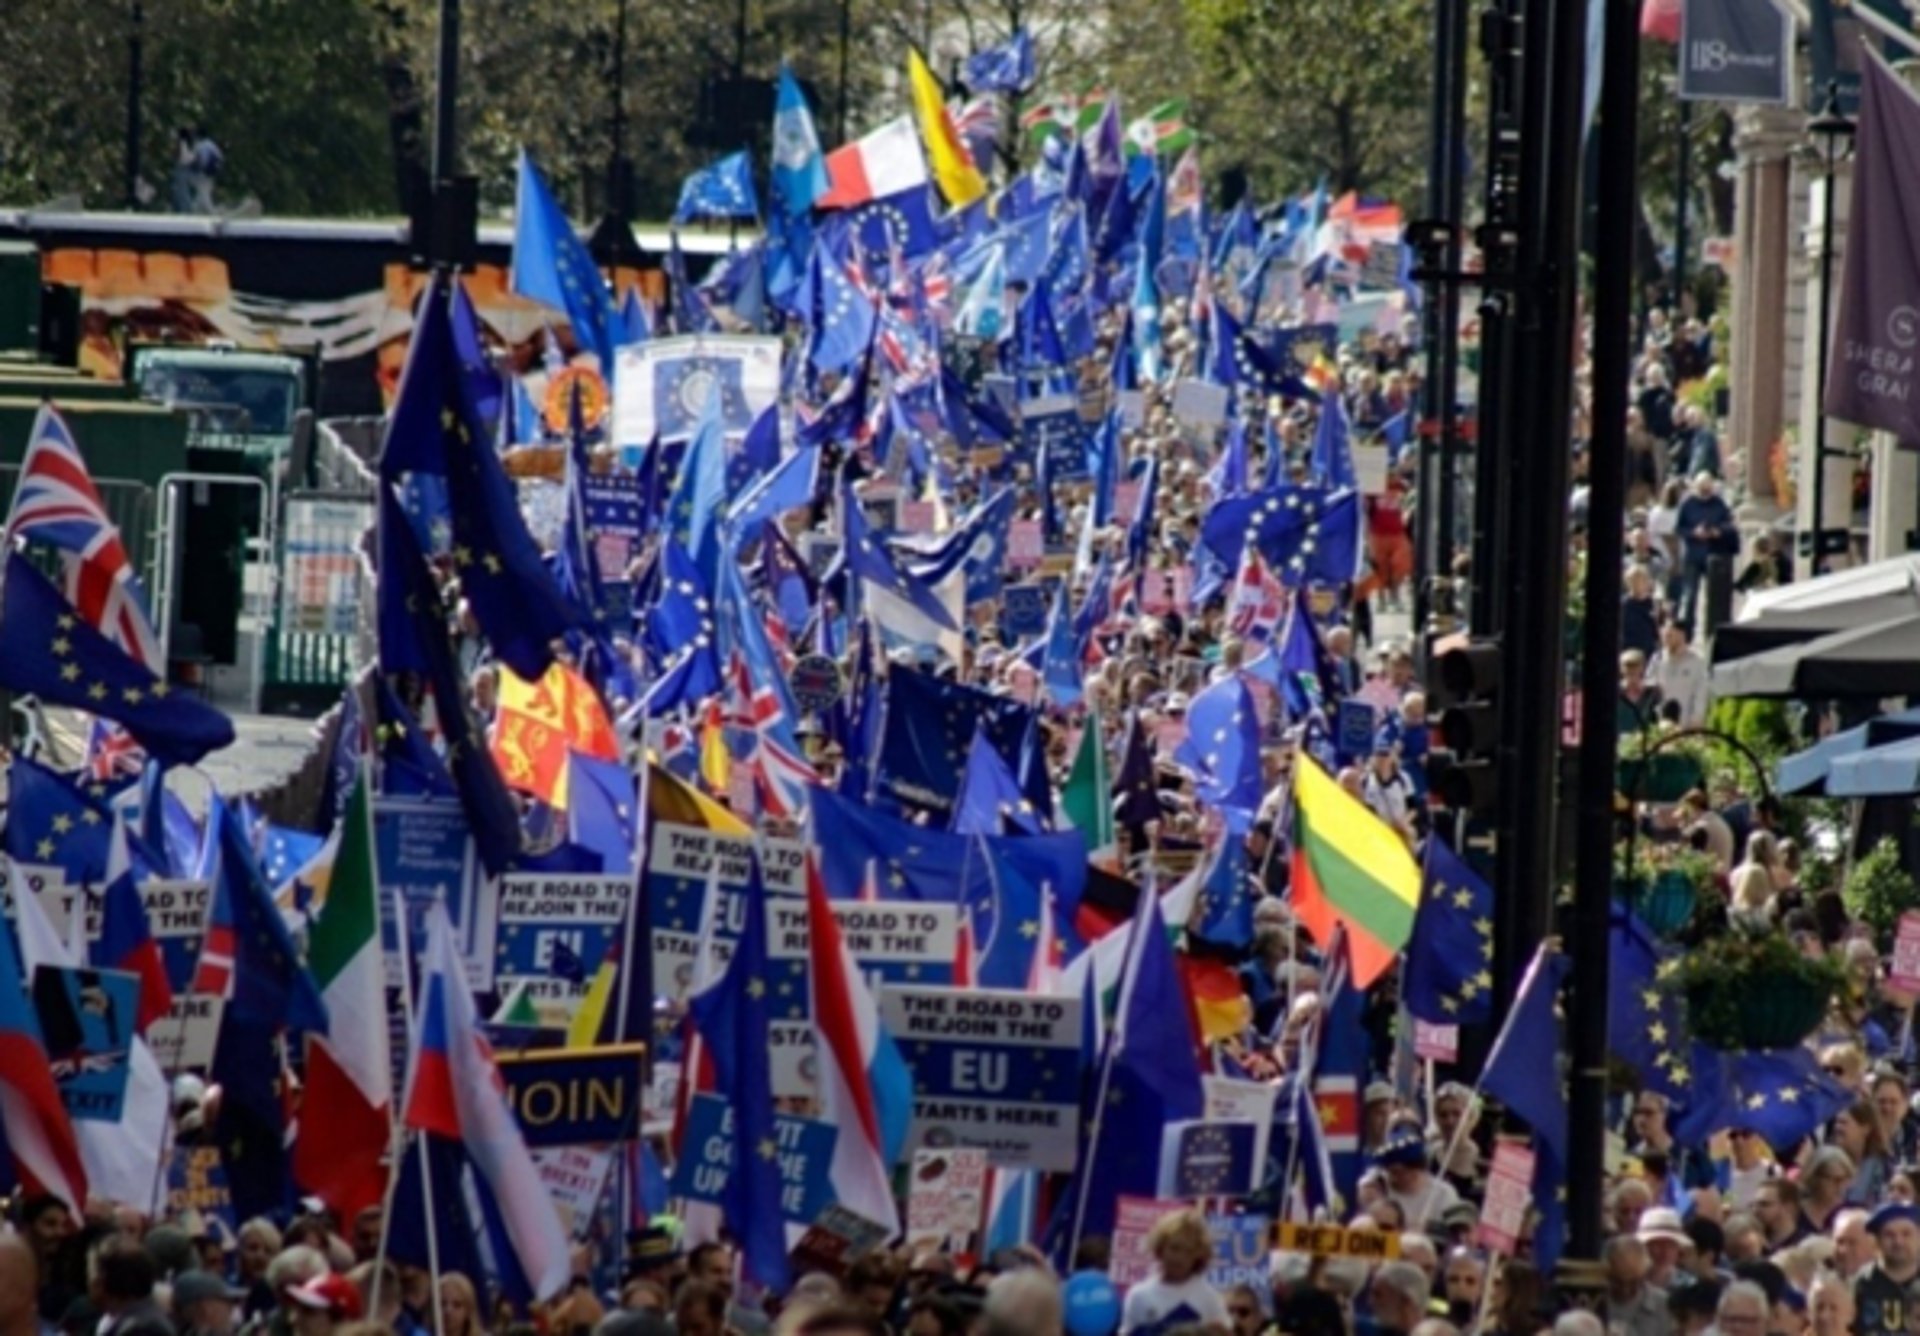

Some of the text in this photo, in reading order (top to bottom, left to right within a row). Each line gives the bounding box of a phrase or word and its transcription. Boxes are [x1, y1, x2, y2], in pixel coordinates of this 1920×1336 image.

[671, 833, 707, 852] THE
[777, 849, 802, 867] TO
[765, 867, 794, 884] HE
[146, 891, 175, 907] AD
[501, 881, 632, 899] THE ROAD TO
[504, 900, 620, 916] REJOIN THE
[160, 911, 204, 929] THE
[776, 910, 809, 928] TH
[906, 913, 938, 932] TO
[783, 932, 927, 953] REIN THE
[171, 1001, 212, 1018] ERE
[902, 995, 1064, 1021] THE ROAD TO
[908, 1016, 1053, 1040] REJOIN THE
[951, 1050, 1011, 1093] EU
[913, 1101, 1060, 1127] TARTS HERE
[1295, 1226, 1386, 1256] REJOIN
